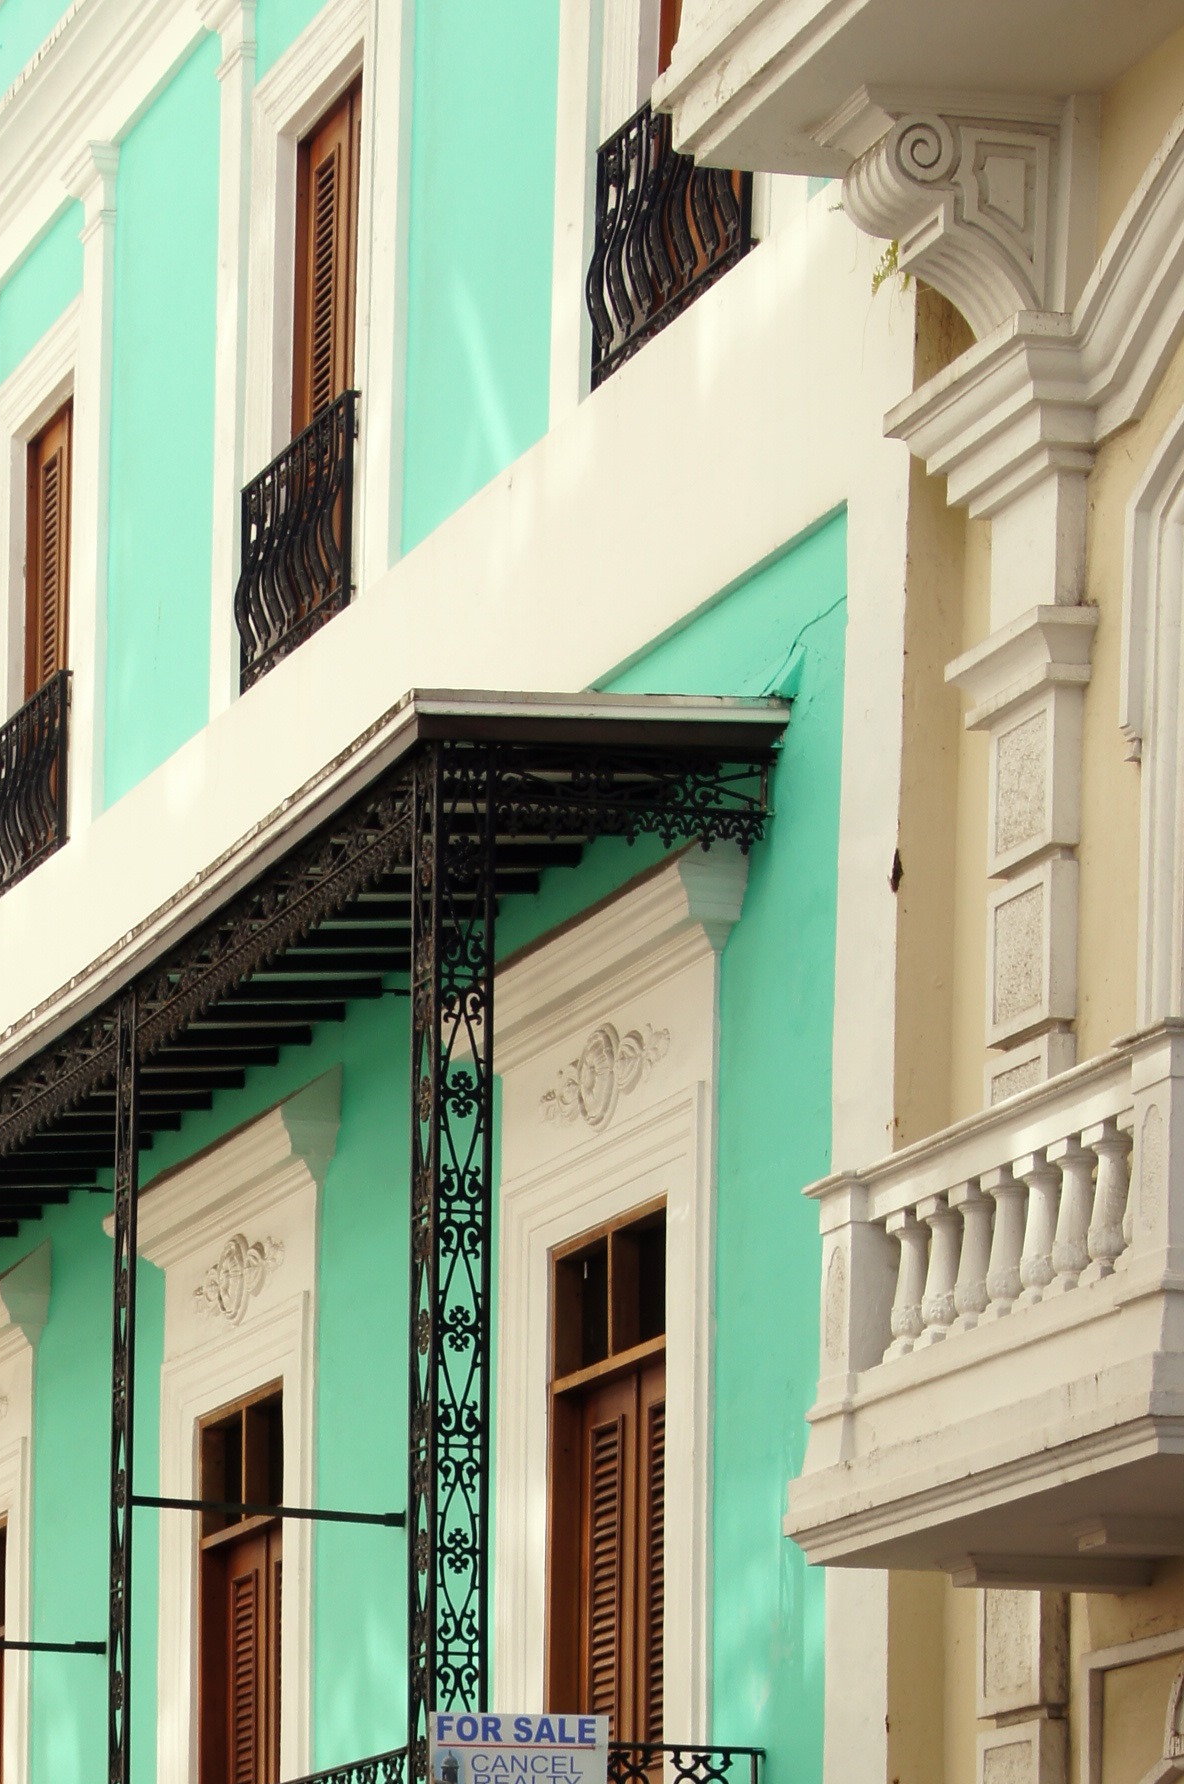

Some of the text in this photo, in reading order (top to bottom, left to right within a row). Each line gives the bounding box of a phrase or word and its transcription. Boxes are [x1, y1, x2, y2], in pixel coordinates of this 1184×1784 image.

[437, 1716, 596, 1744] FOR SALE
[471, 1754, 583, 1775] CANCEL
